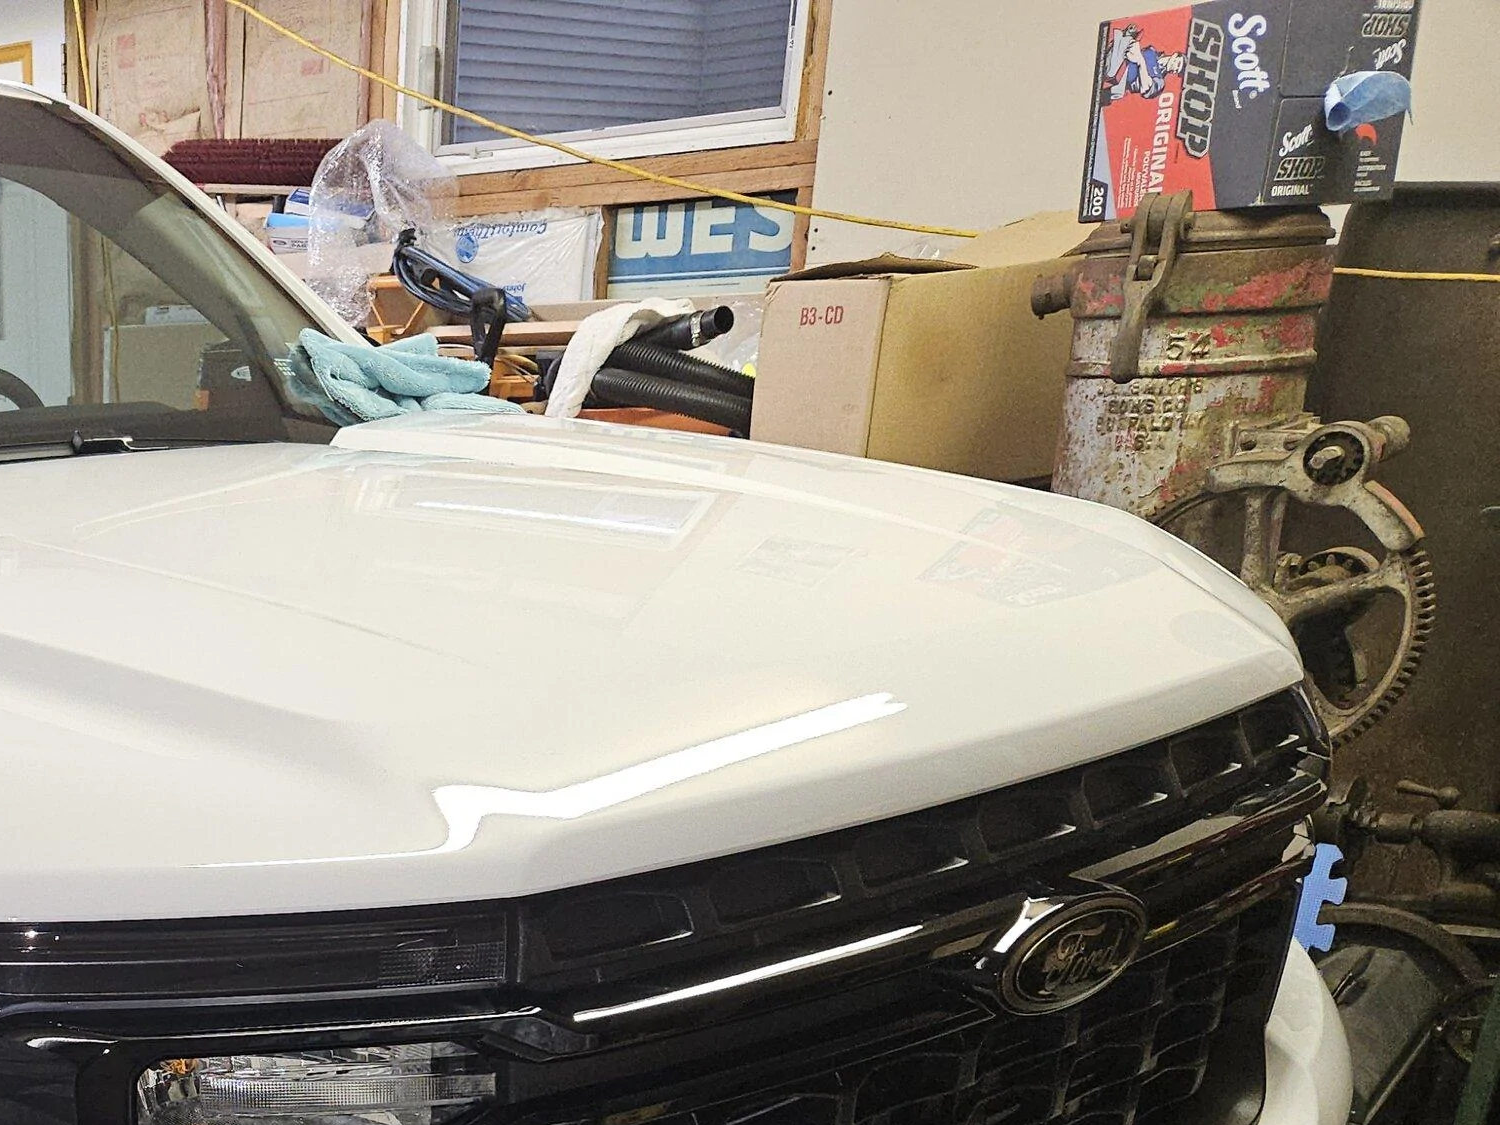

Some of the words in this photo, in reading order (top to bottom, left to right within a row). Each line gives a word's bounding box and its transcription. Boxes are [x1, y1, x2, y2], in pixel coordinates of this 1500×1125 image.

[1227, 13, 1270, 92] Scott
[1175, 18, 1225, 158] SHOP
[1279, 124, 1313, 157] Scott
[1273, 156, 1325, 181] SHOP
[1091, 186, 1105, 216] 200
[1271, 184, 1310, 197] ORIGINAL
[799, 305, 844, 325] B3-CD
[1166, 333, 1211, 360] 54
[1043, 922, 1126, 992] Ford
